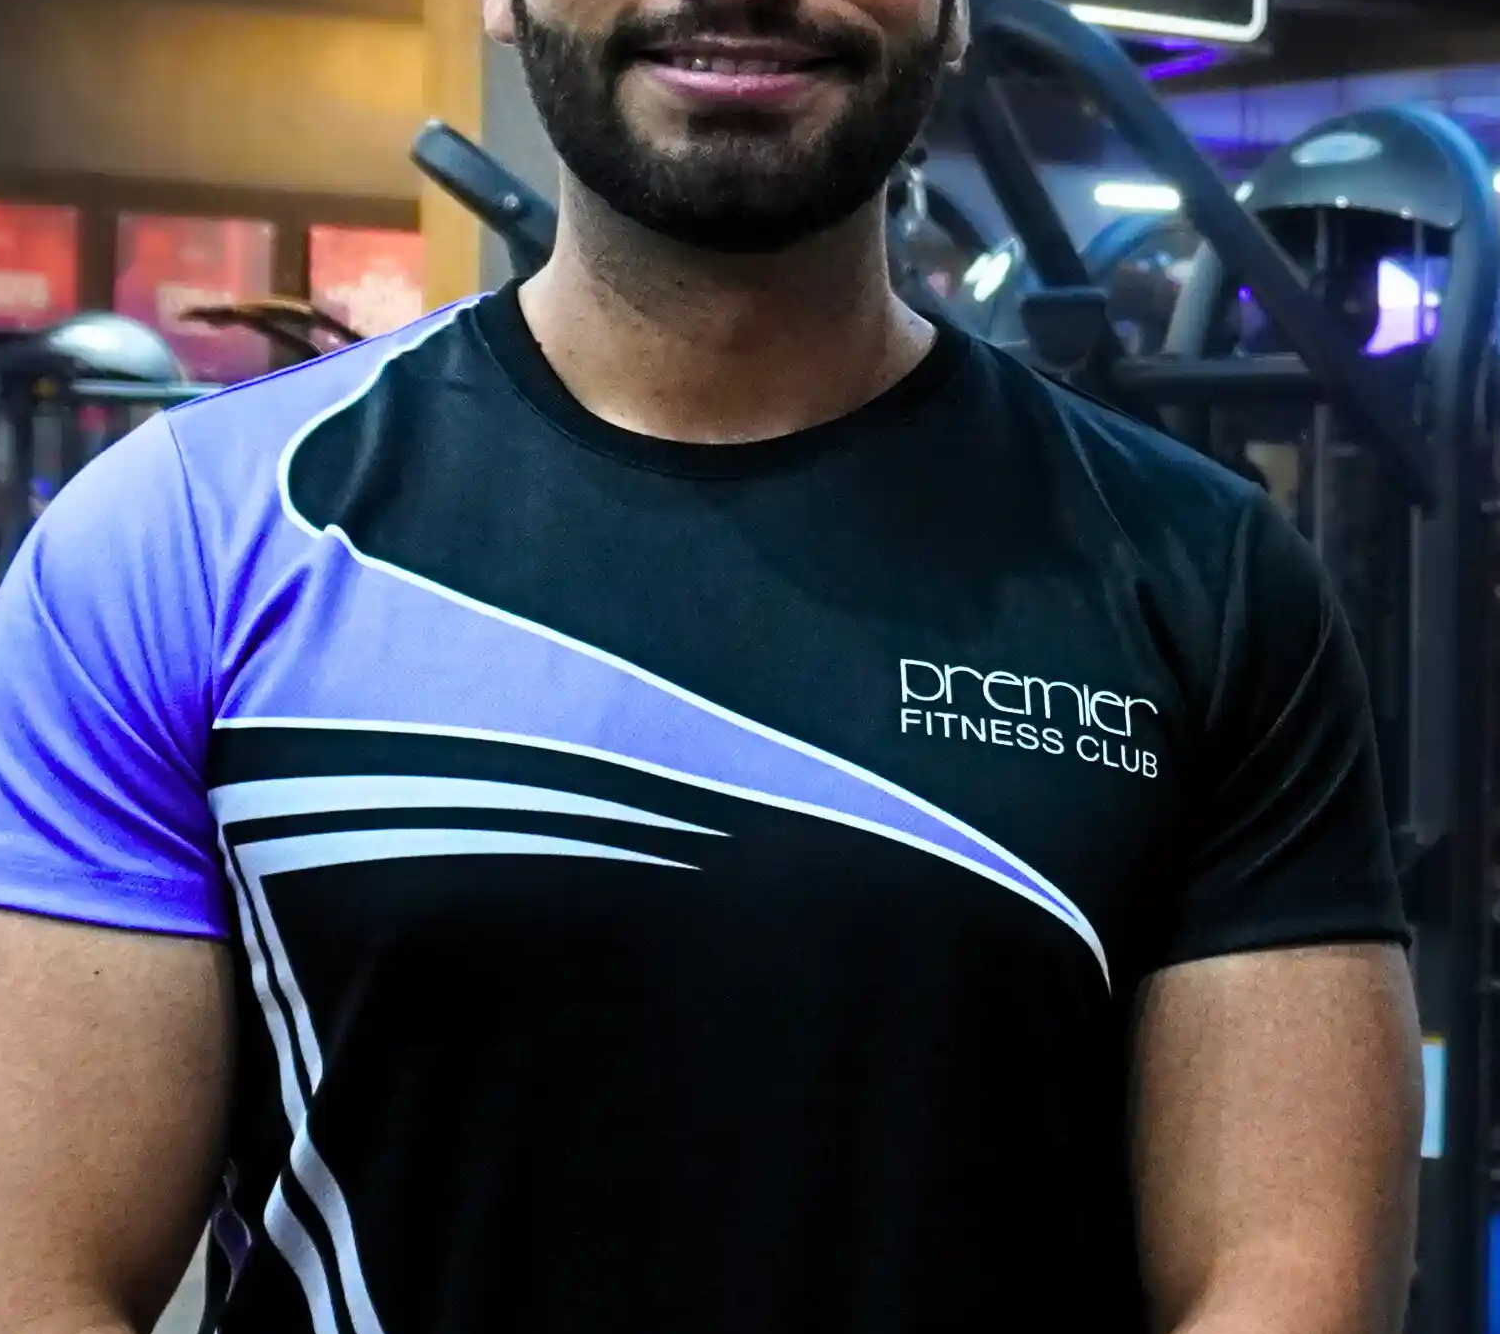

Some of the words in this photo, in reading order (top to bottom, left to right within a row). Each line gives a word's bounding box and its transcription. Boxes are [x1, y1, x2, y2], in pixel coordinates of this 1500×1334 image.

[900, 658, 1158, 737] premier
[901, 708, 1065, 755] FITNESS
[1076, 735, 1158, 779] CLUB
